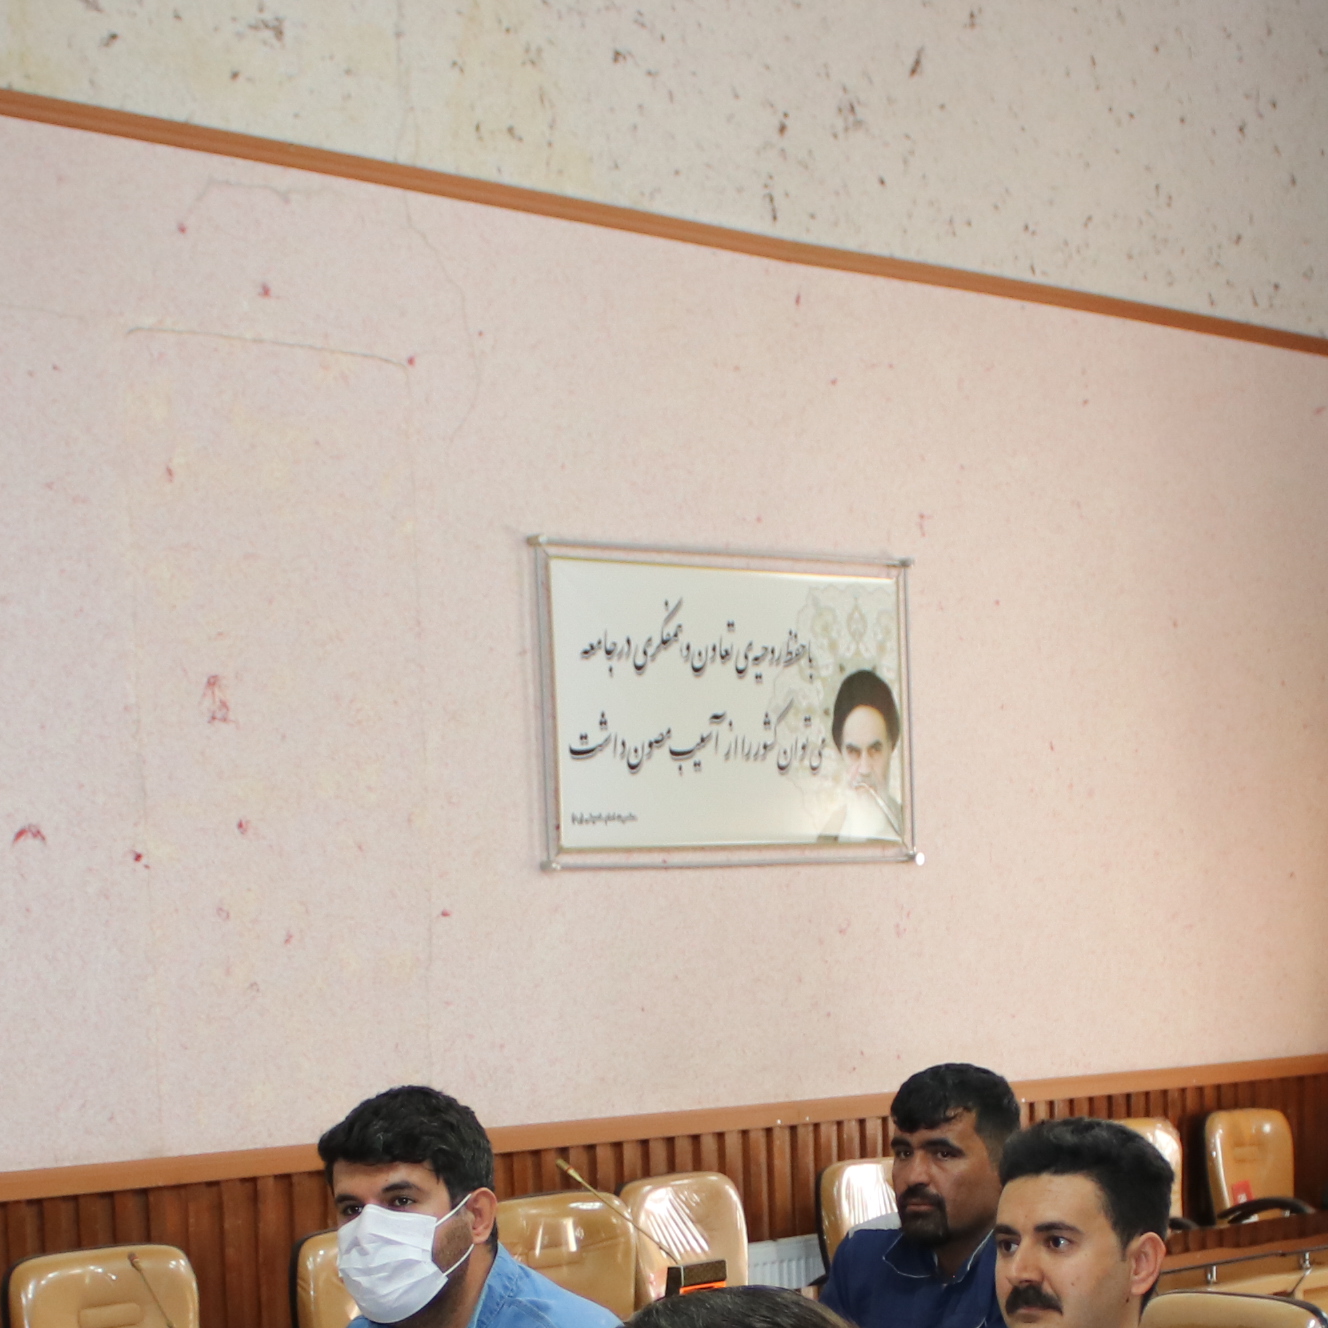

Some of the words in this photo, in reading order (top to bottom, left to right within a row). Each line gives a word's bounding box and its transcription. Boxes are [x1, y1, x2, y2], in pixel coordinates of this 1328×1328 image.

[579, 628, 617, 678] جامعه
[616, 635, 632, 661] در
[633, 596, 683, 676] همفکری
[690, 619, 735, 678] تعاون
[783, 628, 808, 668] حفظ
[568, 709, 626, 761] داشت
[626, 726, 672, 775] مصون
[669, 711, 727, 777] آسیب
[724, 719, 739, 762] از
[740, 734, 753, 762] را
[753, 697, 794, 762] کشور
